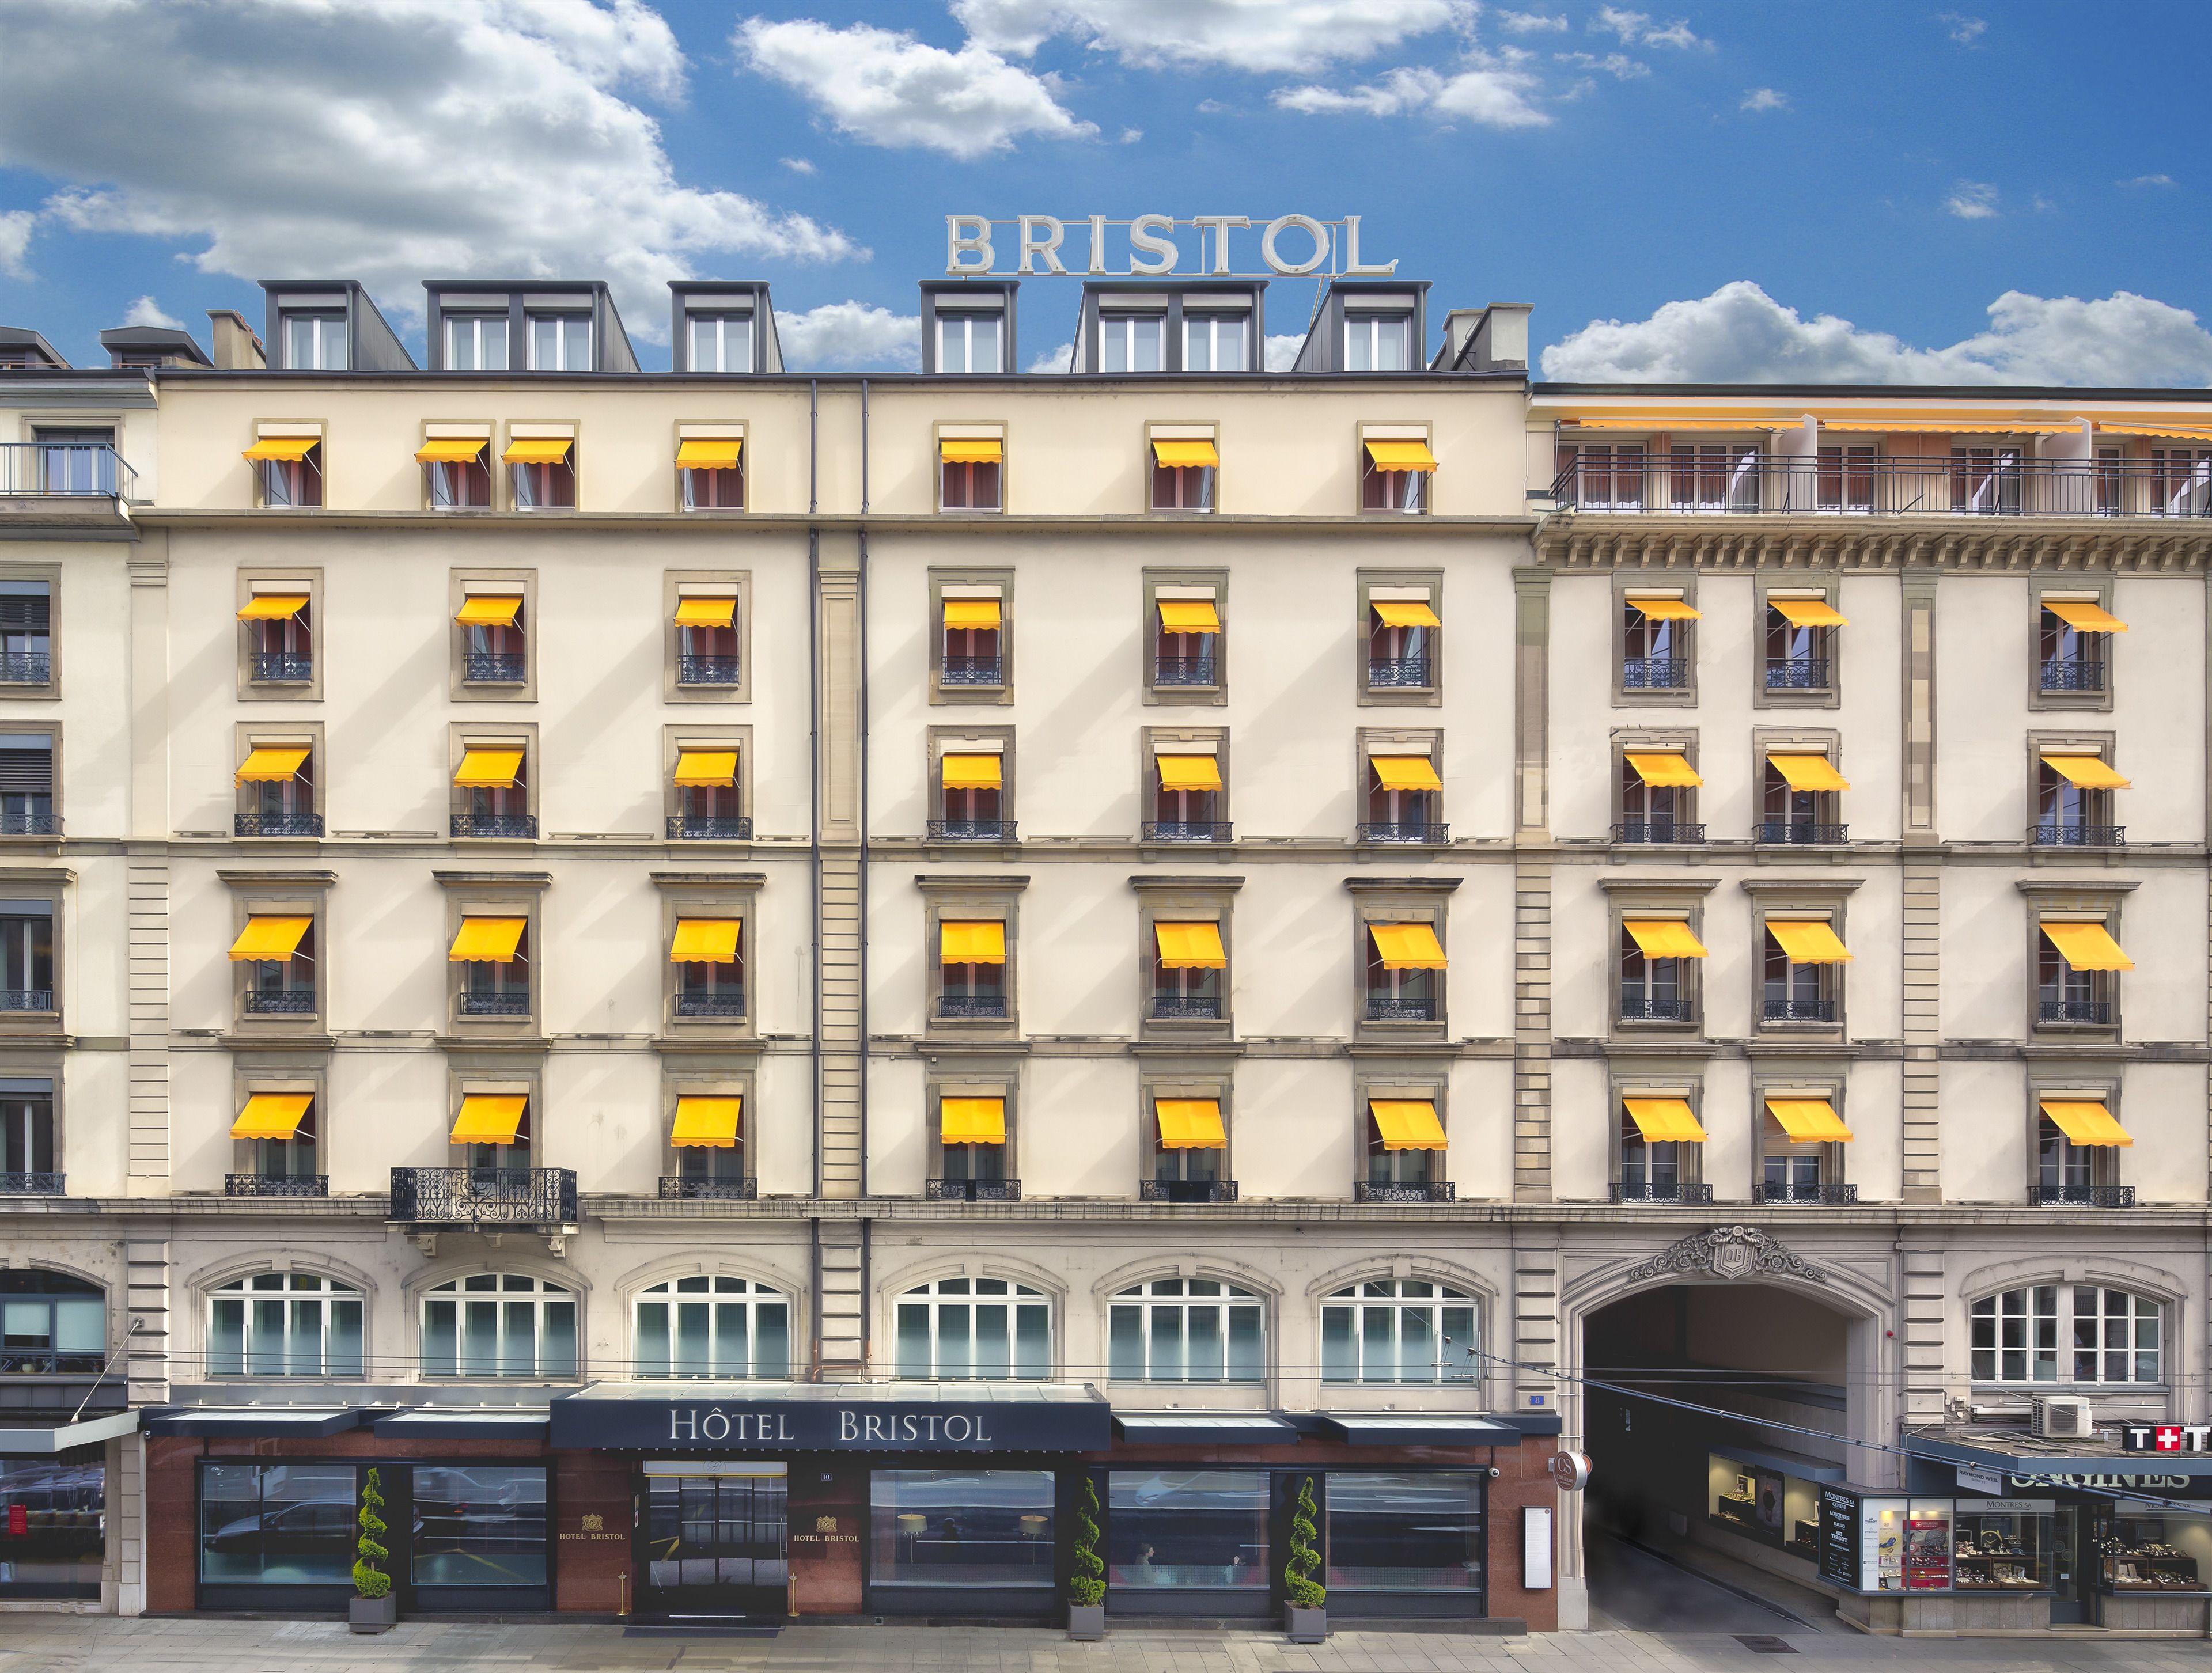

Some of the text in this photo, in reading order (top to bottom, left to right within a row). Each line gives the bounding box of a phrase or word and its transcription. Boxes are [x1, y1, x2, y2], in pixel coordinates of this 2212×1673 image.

[946, 214, 1399, 276] BRISTOL
[669, 1407, 992, 1441] HÔTEL BRISTOL
[1558, 1457, 1571, 1474] CS
[1959, 1470, 1999, 1484] RAYMOND WEIL
[1825, 1490, 1849, 1504] MONTRES
[1830, 1510, 1850, 1521] LONGINES
[1831, 1533, 1848, 1543] TISSOT
